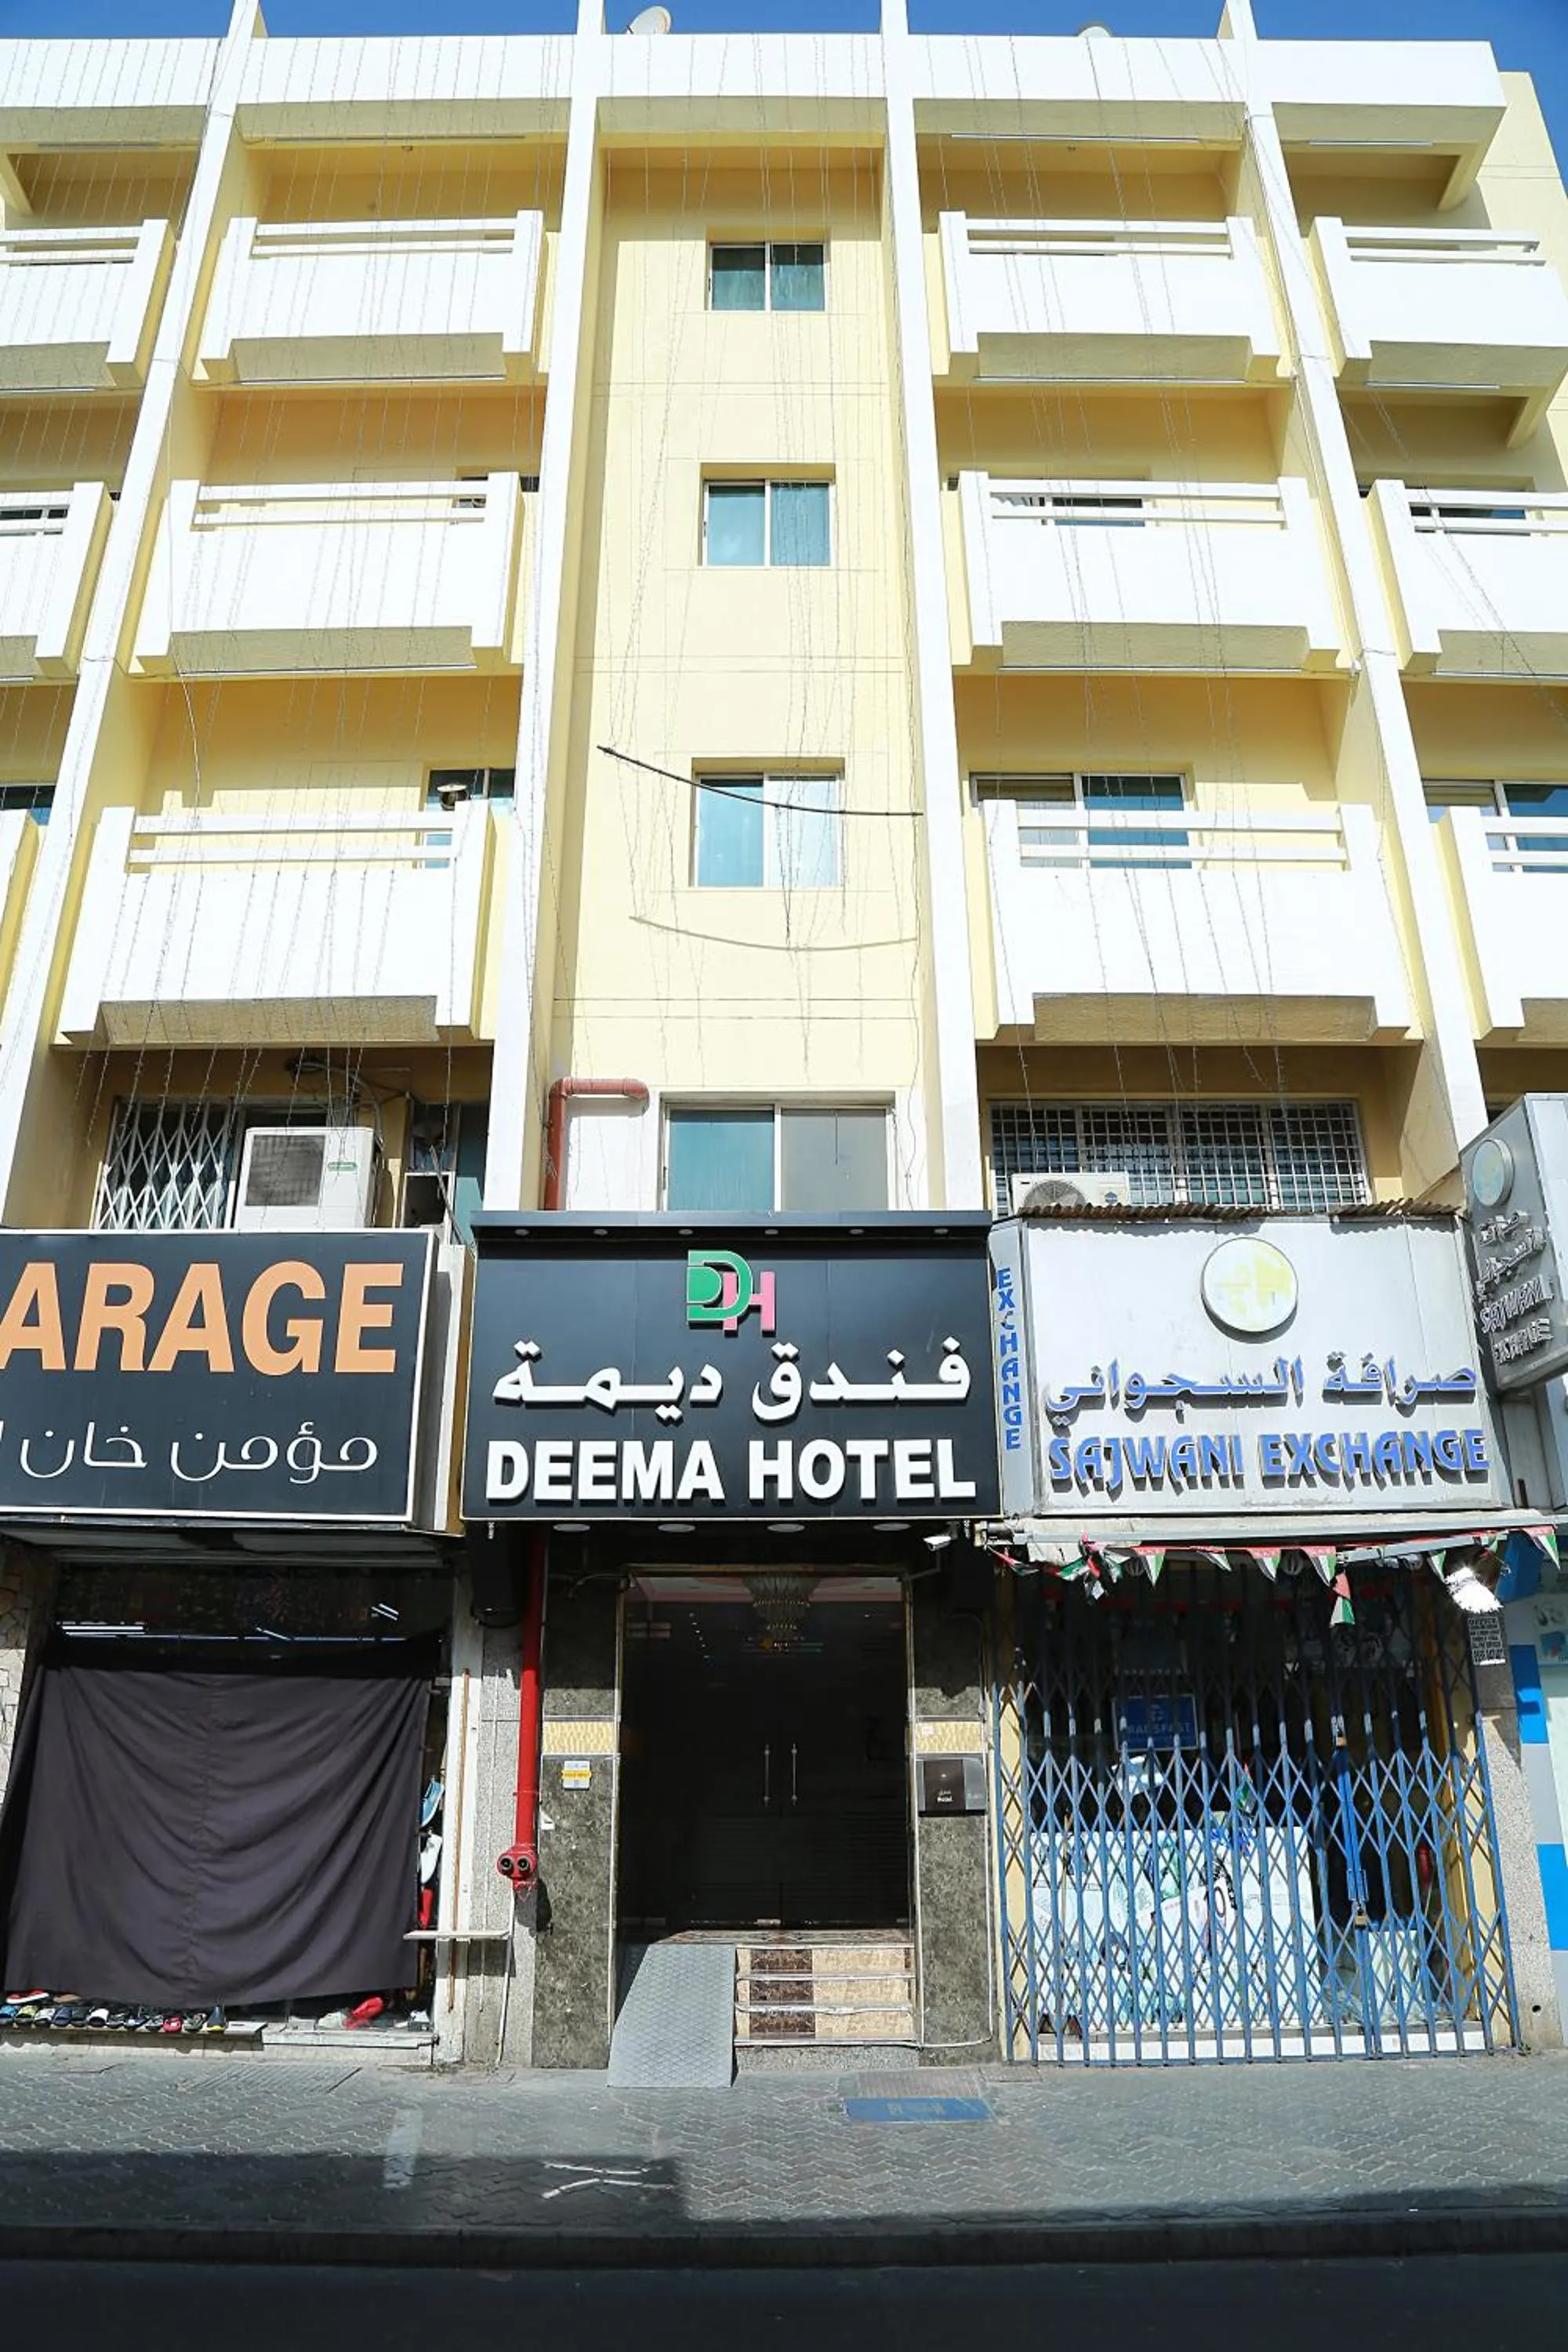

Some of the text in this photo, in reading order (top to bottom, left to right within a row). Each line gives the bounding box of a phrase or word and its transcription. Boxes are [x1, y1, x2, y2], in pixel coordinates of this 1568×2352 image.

[0, 1261, 403, 1375] ARAGE
[492, 1335, 971, 1422] فندق ديمة
[1046, 1351, 1476, 1427] صرافة السجواني
[20, 1421, 378, 1484] مؤمن خان
[485, 1438, 977, 1501] DEEMA HOTEL
[1048, 1428, 1491, 1489] SAJWANI EXCHANGE
